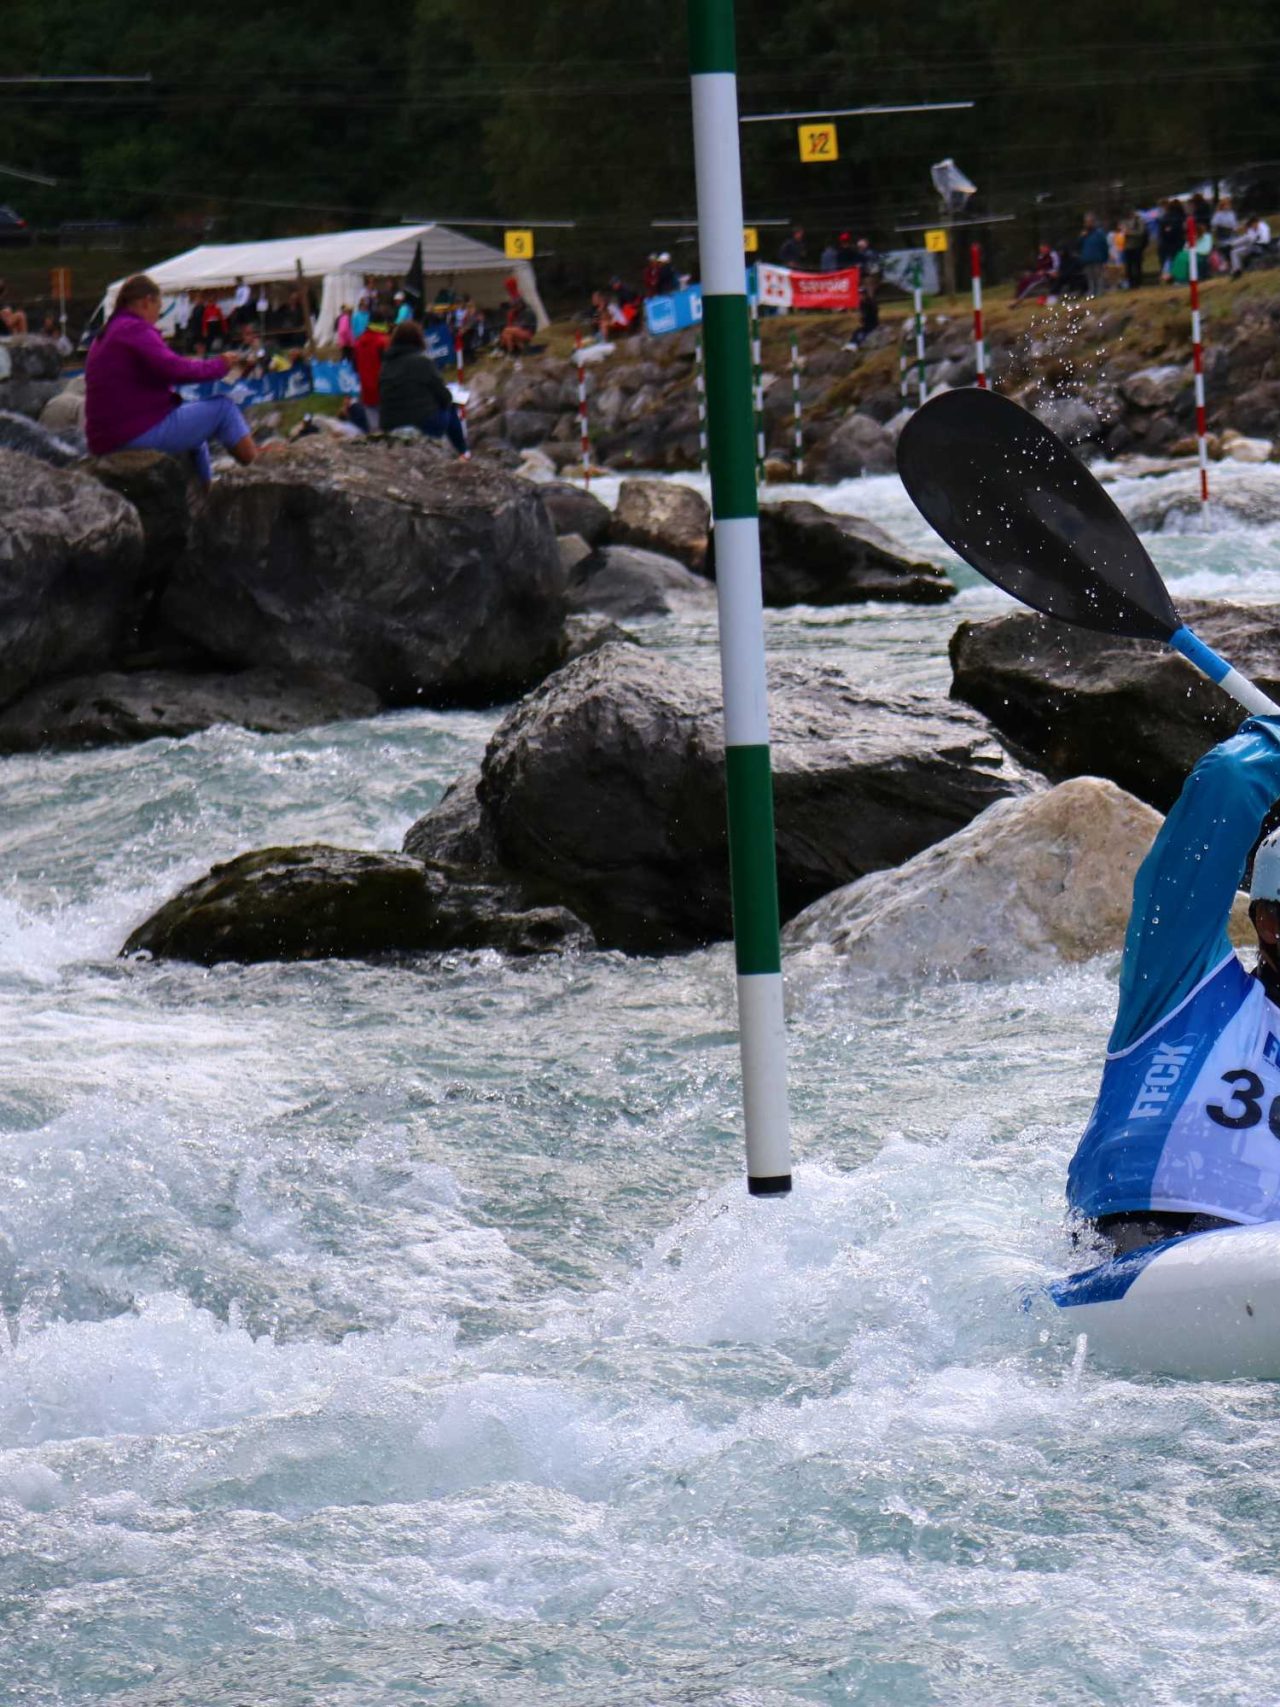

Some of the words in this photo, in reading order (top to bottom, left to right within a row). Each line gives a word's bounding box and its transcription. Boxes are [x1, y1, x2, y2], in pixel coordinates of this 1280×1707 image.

[808, 132, 830, 154] 12
[513, 236, 525, 253] 9
[1127, 1042, 1194, 1119] FFCK
